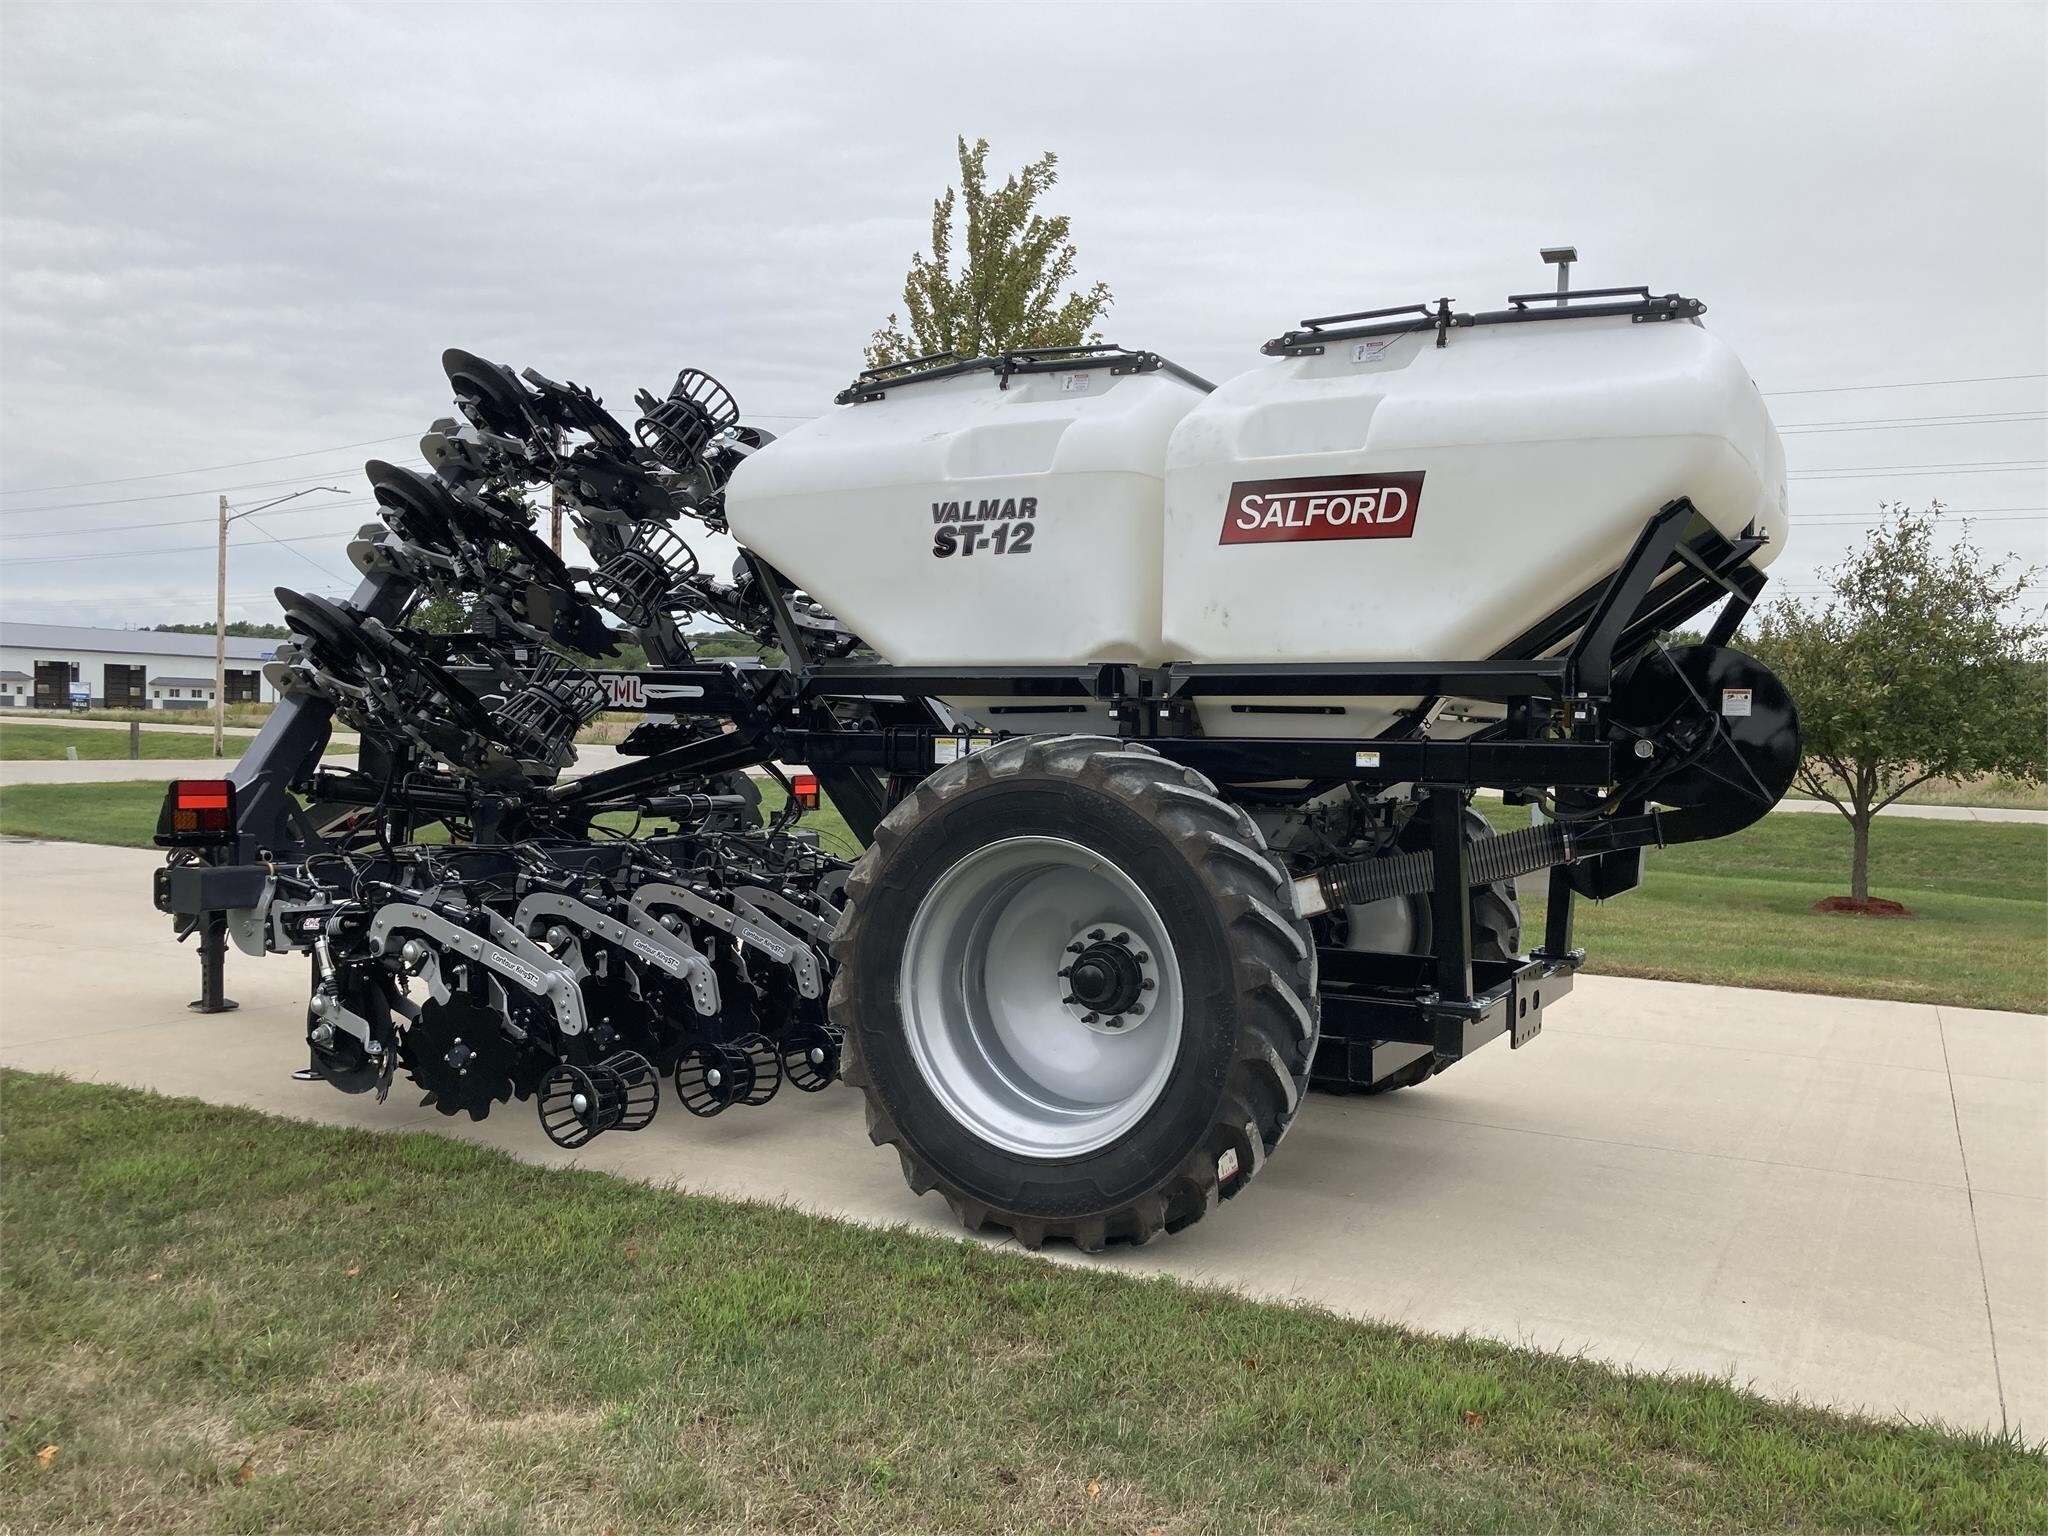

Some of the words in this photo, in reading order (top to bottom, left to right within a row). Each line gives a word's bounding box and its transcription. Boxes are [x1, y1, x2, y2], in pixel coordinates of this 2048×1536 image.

[931, 497, 1038, 524] VALMAR
[1236, 487, 1408, 530] SALFORD
[932, 521, 1036, 558] ST-12
[634, 939, 656, 954] Contour
[492, 953, 516, 970] Contour
